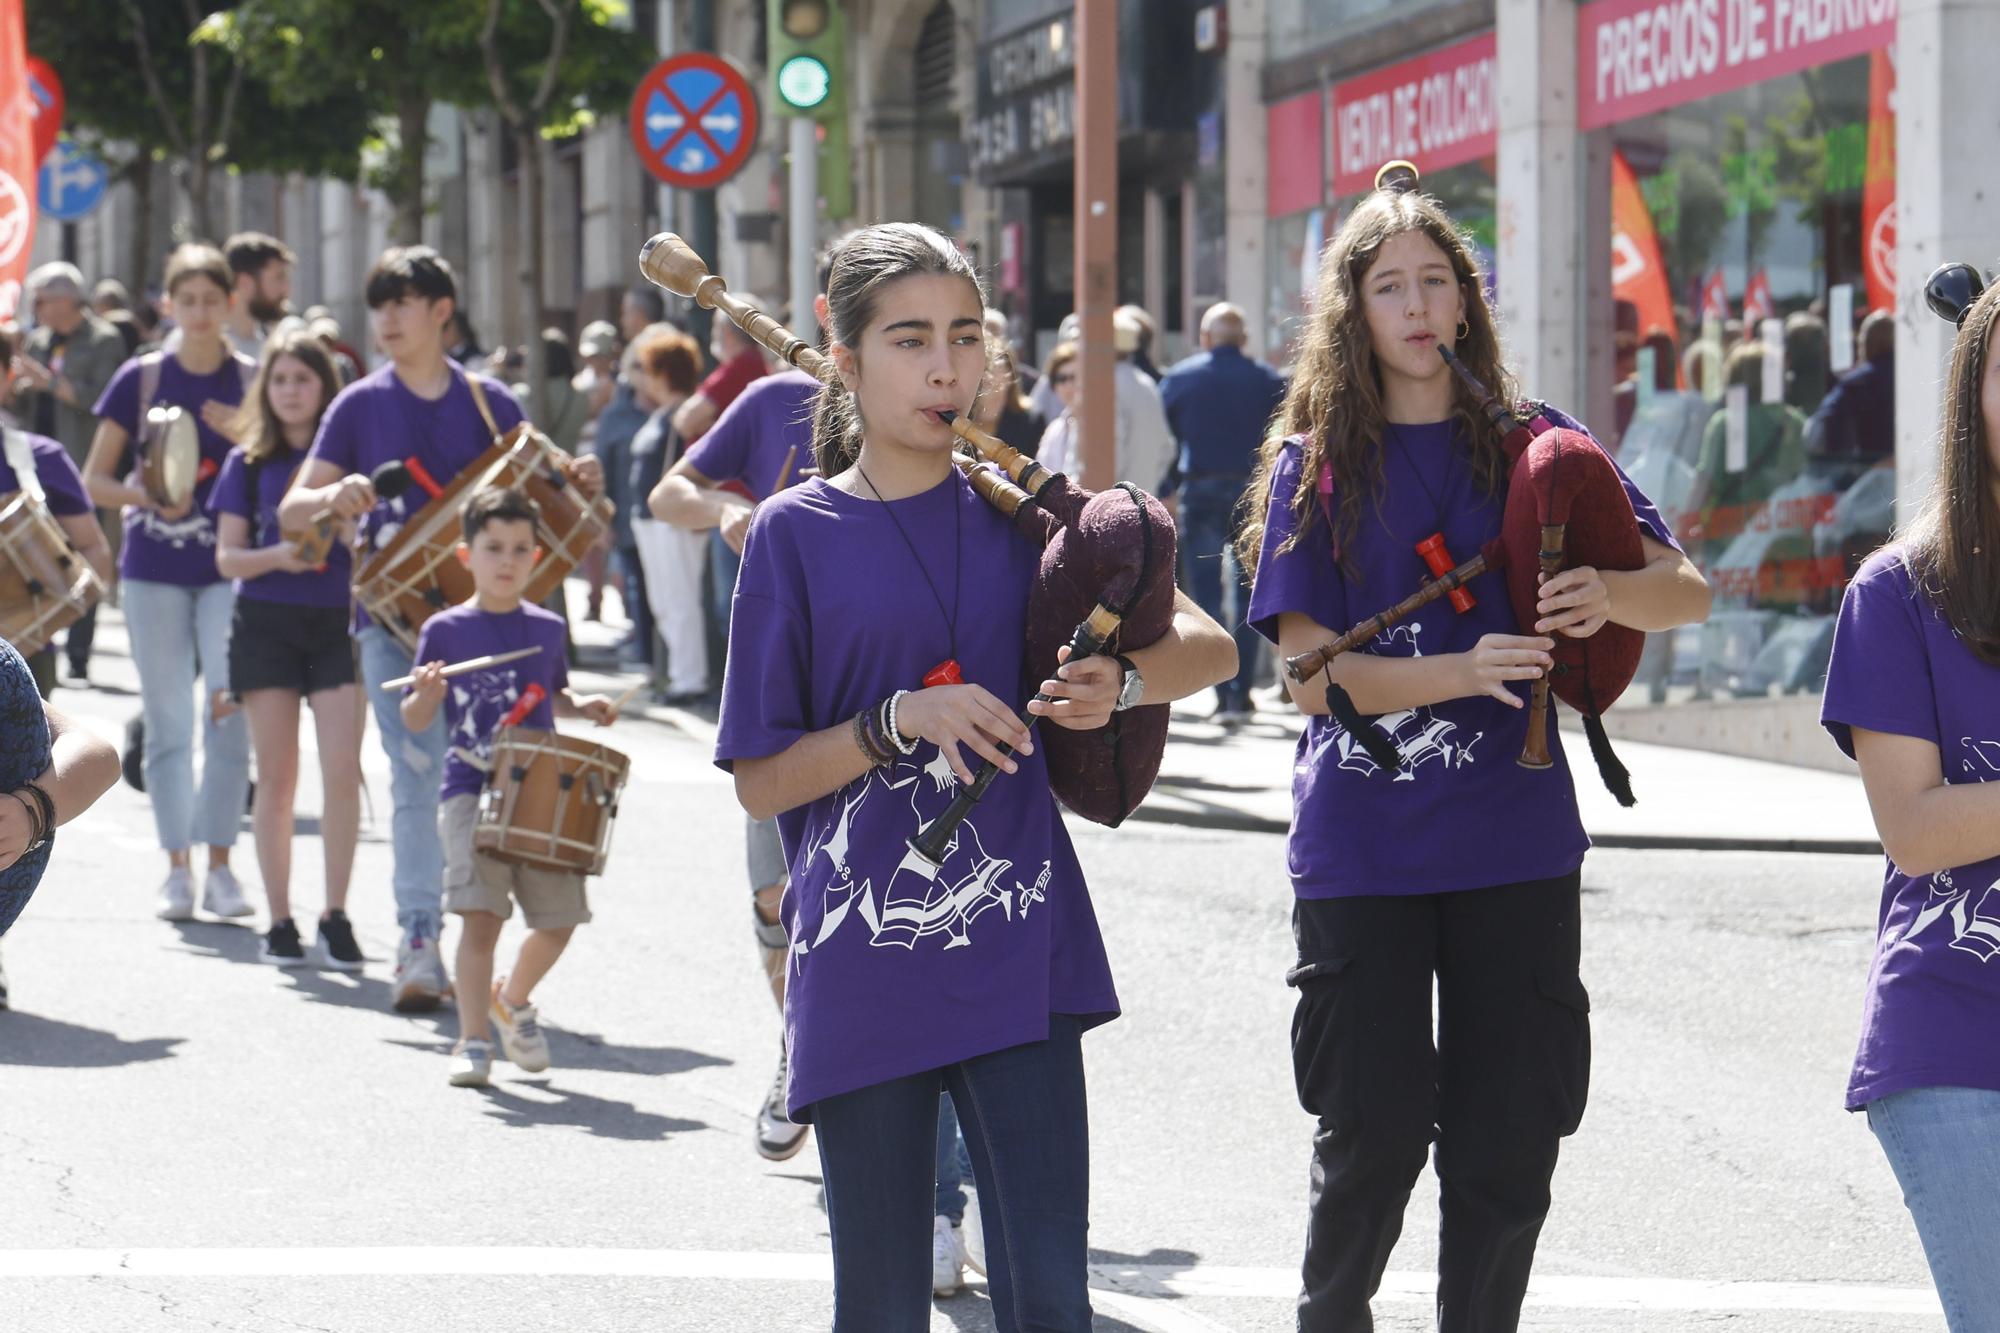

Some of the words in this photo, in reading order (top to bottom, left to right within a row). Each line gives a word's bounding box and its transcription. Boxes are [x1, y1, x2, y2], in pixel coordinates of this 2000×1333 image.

[1597, 0, 1719, 103] PRECIOS
[1726, 0, 1768, 66] DE
[1338, 92, 1391, 176] VENTA
[1393, 81, 1418, 157] DE
